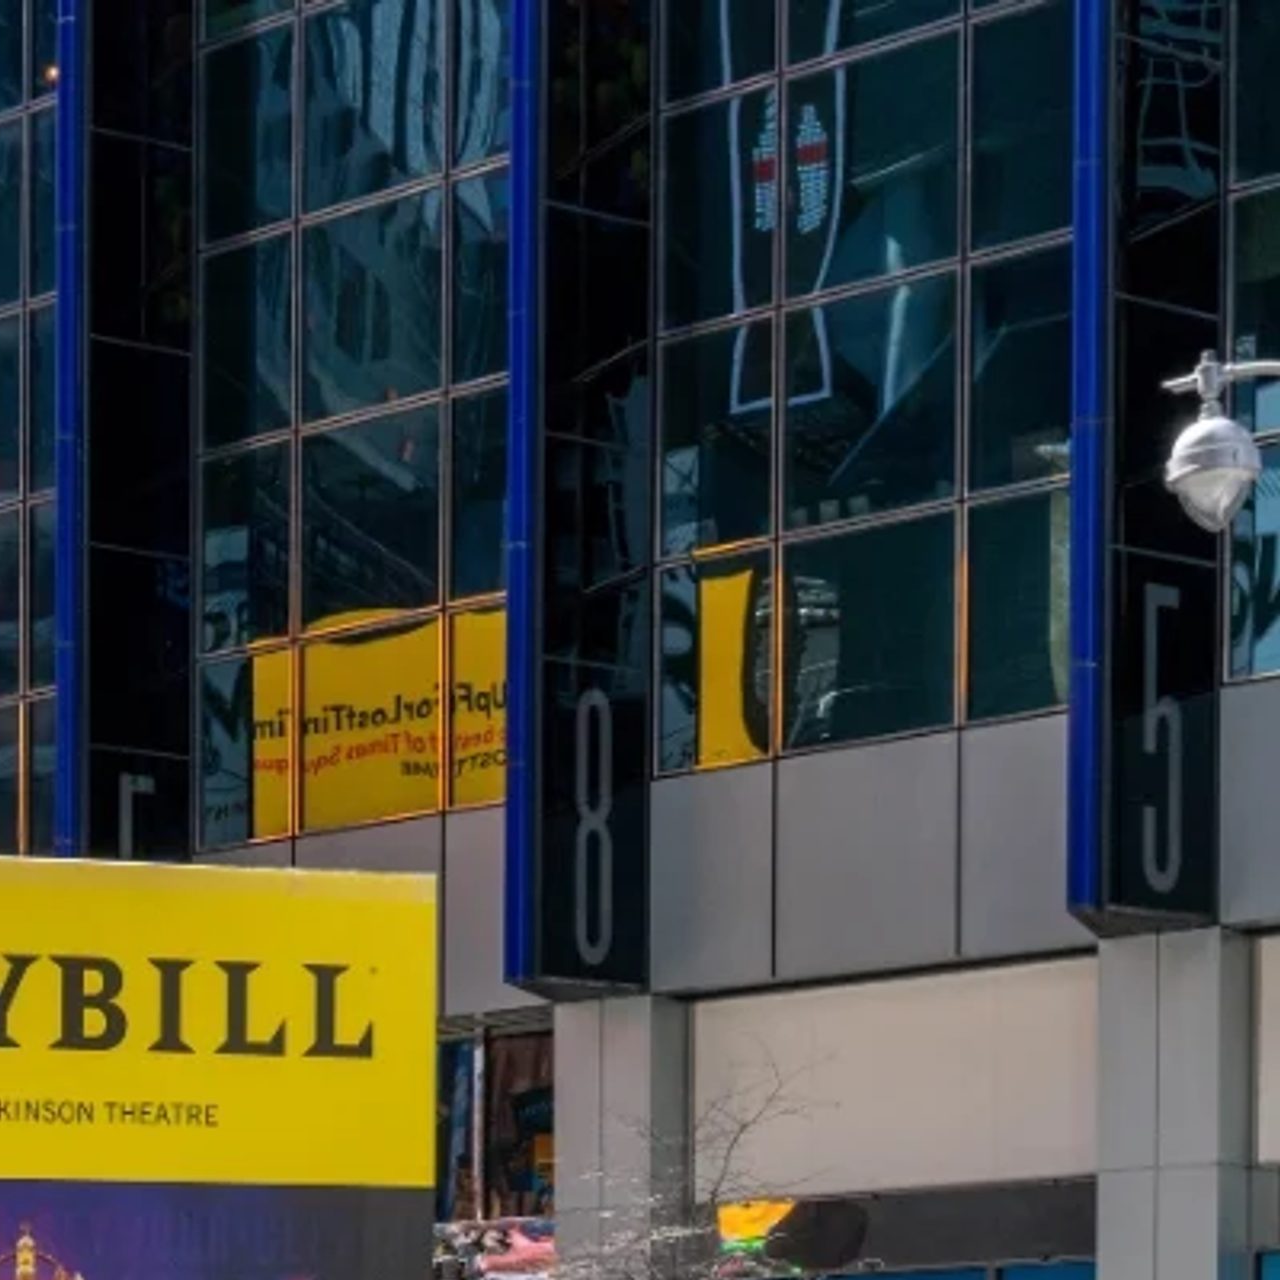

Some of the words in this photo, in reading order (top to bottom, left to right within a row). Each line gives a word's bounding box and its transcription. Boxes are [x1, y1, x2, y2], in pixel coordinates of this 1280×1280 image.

[575, 687, 613, 966] 8
[1143, 583, 1183, 893] 5
[104, 1099, 220, 1129] THEATRE
